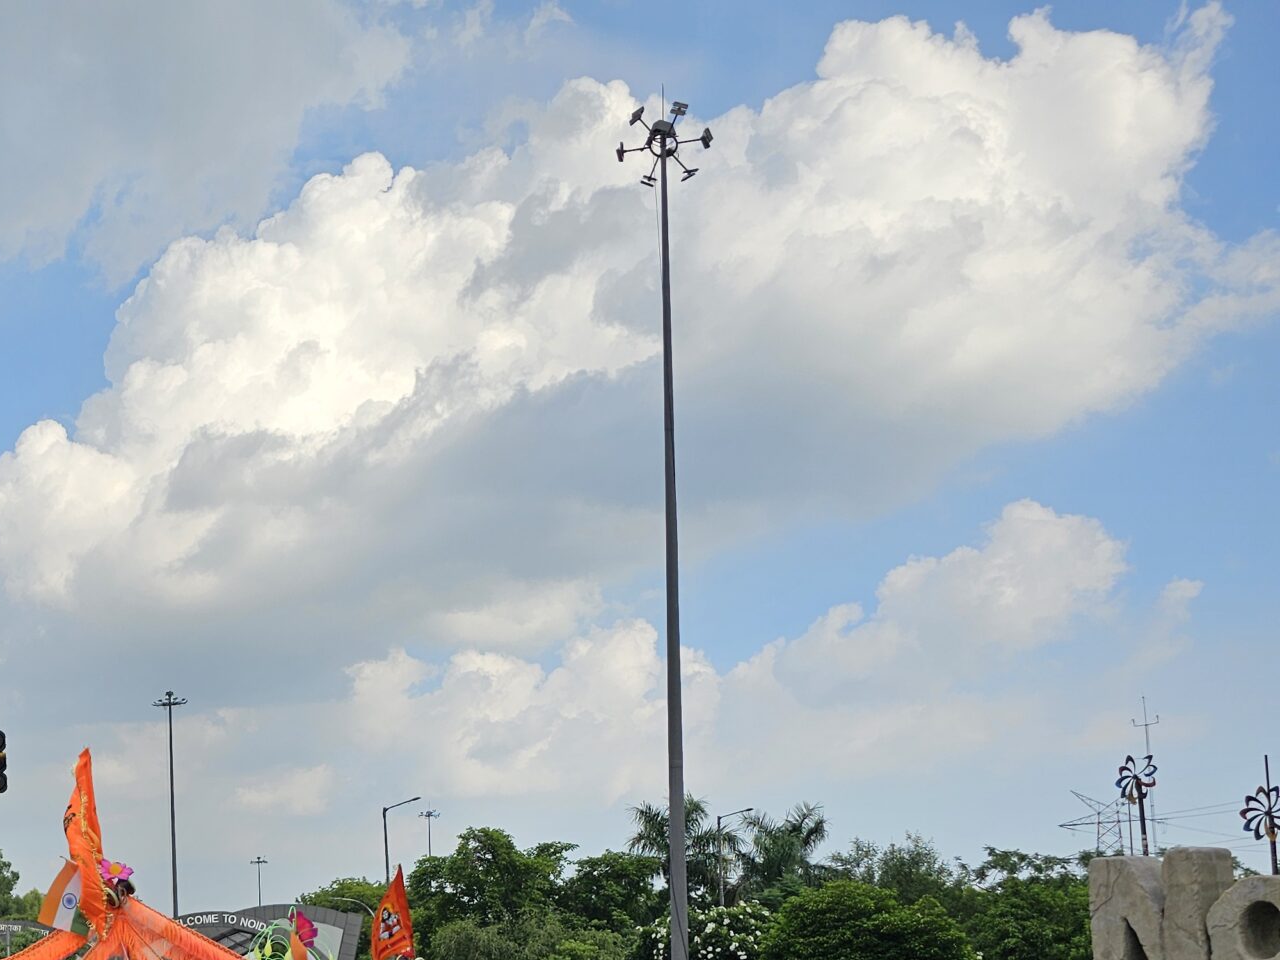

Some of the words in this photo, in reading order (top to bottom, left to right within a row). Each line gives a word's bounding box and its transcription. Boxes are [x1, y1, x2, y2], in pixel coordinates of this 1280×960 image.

[176, 914, 219, 927] LCOME
[222, 914, 237, 924] TO
[240, 917, 266, 931] NOID
